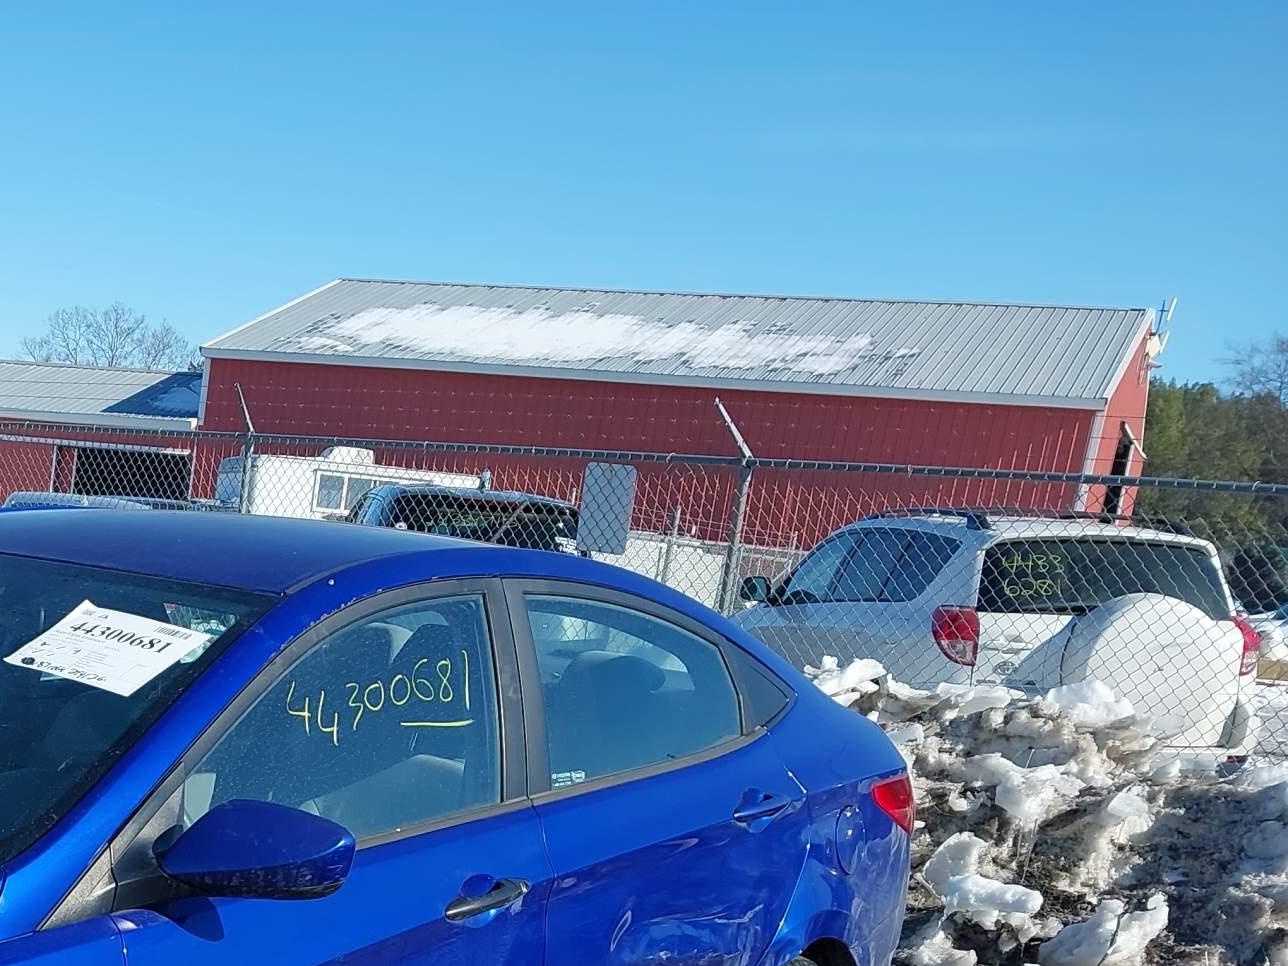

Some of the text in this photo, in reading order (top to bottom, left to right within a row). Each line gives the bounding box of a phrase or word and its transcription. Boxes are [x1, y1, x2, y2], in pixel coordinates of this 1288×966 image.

[1004, 576, 1062, 597] 6281
[69, 621, 174, 654] 44300681
[285, 649, 472, 747] 44300681
